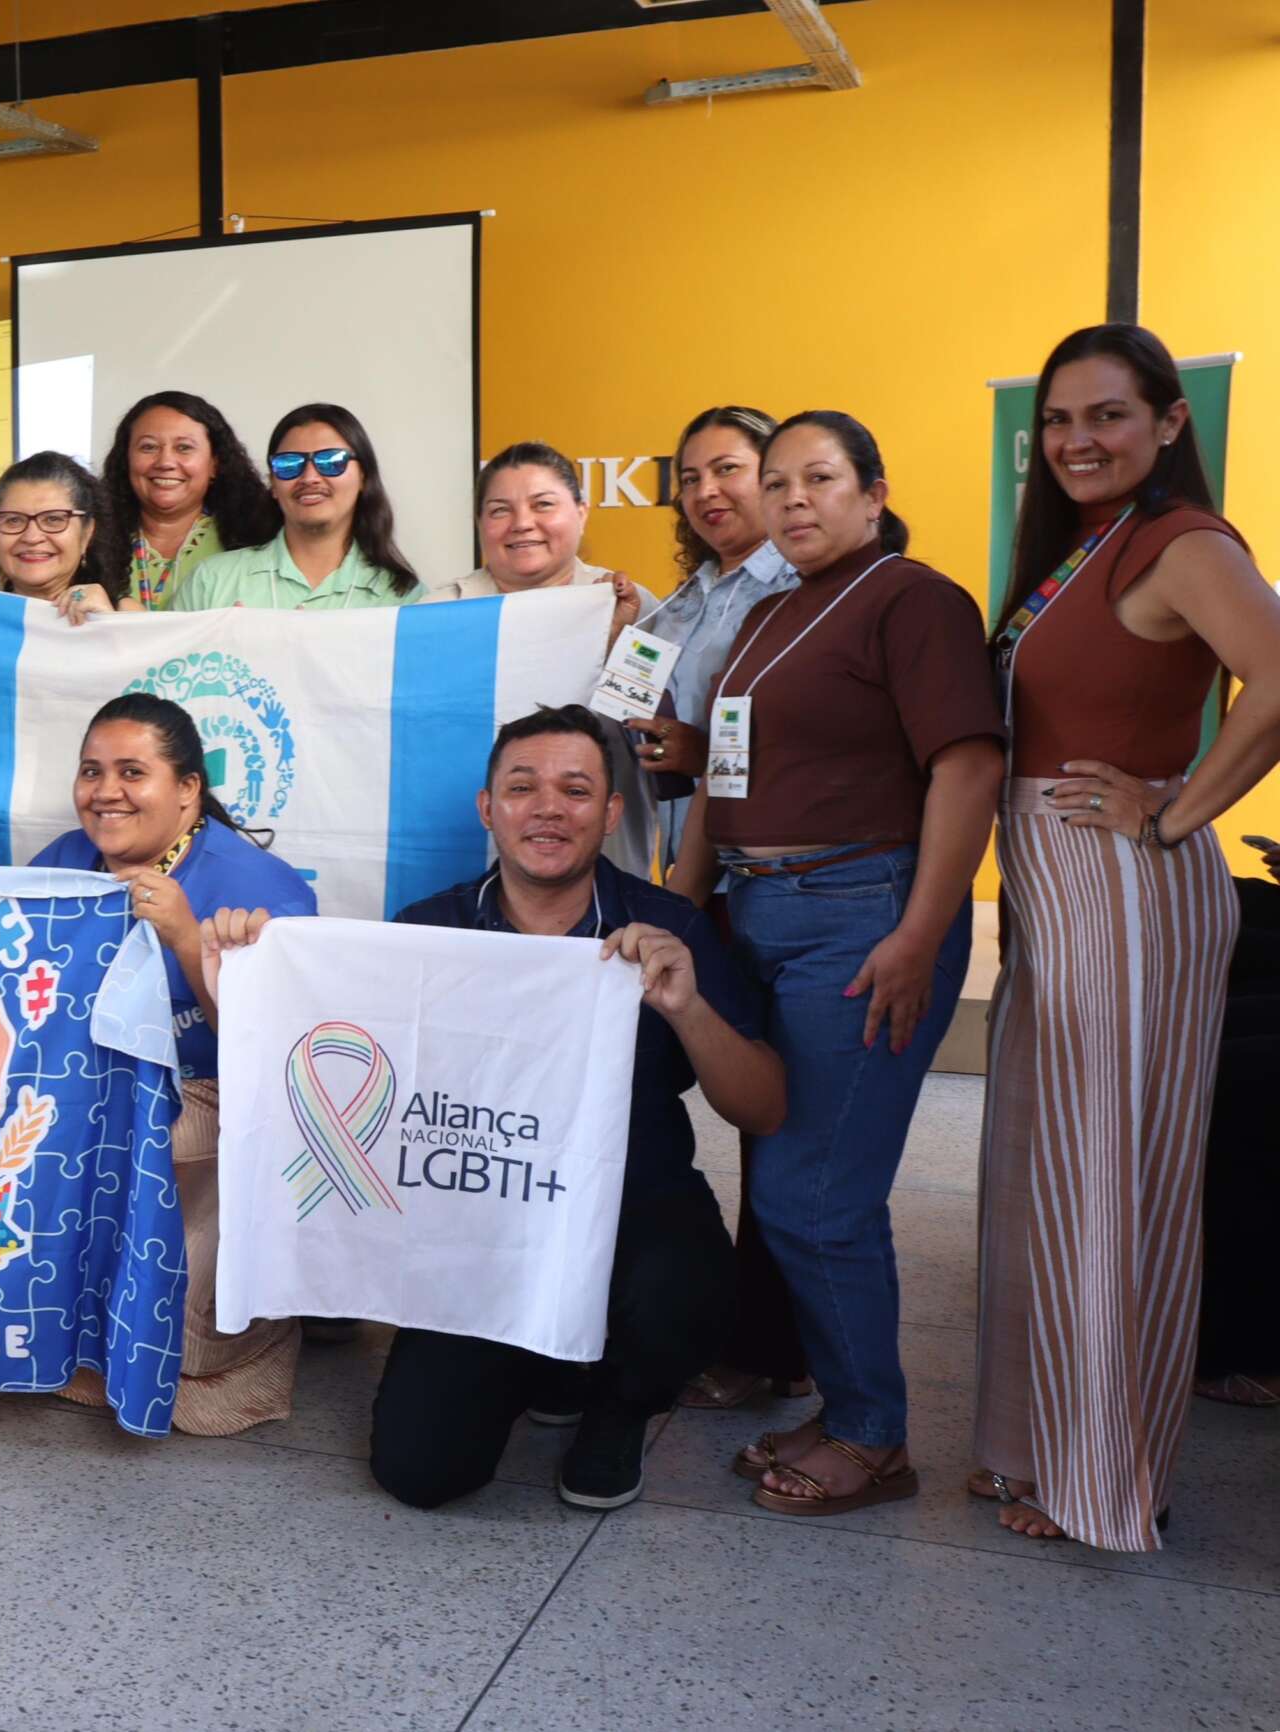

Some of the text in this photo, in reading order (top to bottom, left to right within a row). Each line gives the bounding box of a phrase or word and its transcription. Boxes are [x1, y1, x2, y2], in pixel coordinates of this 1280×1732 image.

[400, 1091, 541, 1148] Aliança
[400, 1128, 499, 1152] NACIONAL
[397, 1145, 567, 1202] LGBTI+
